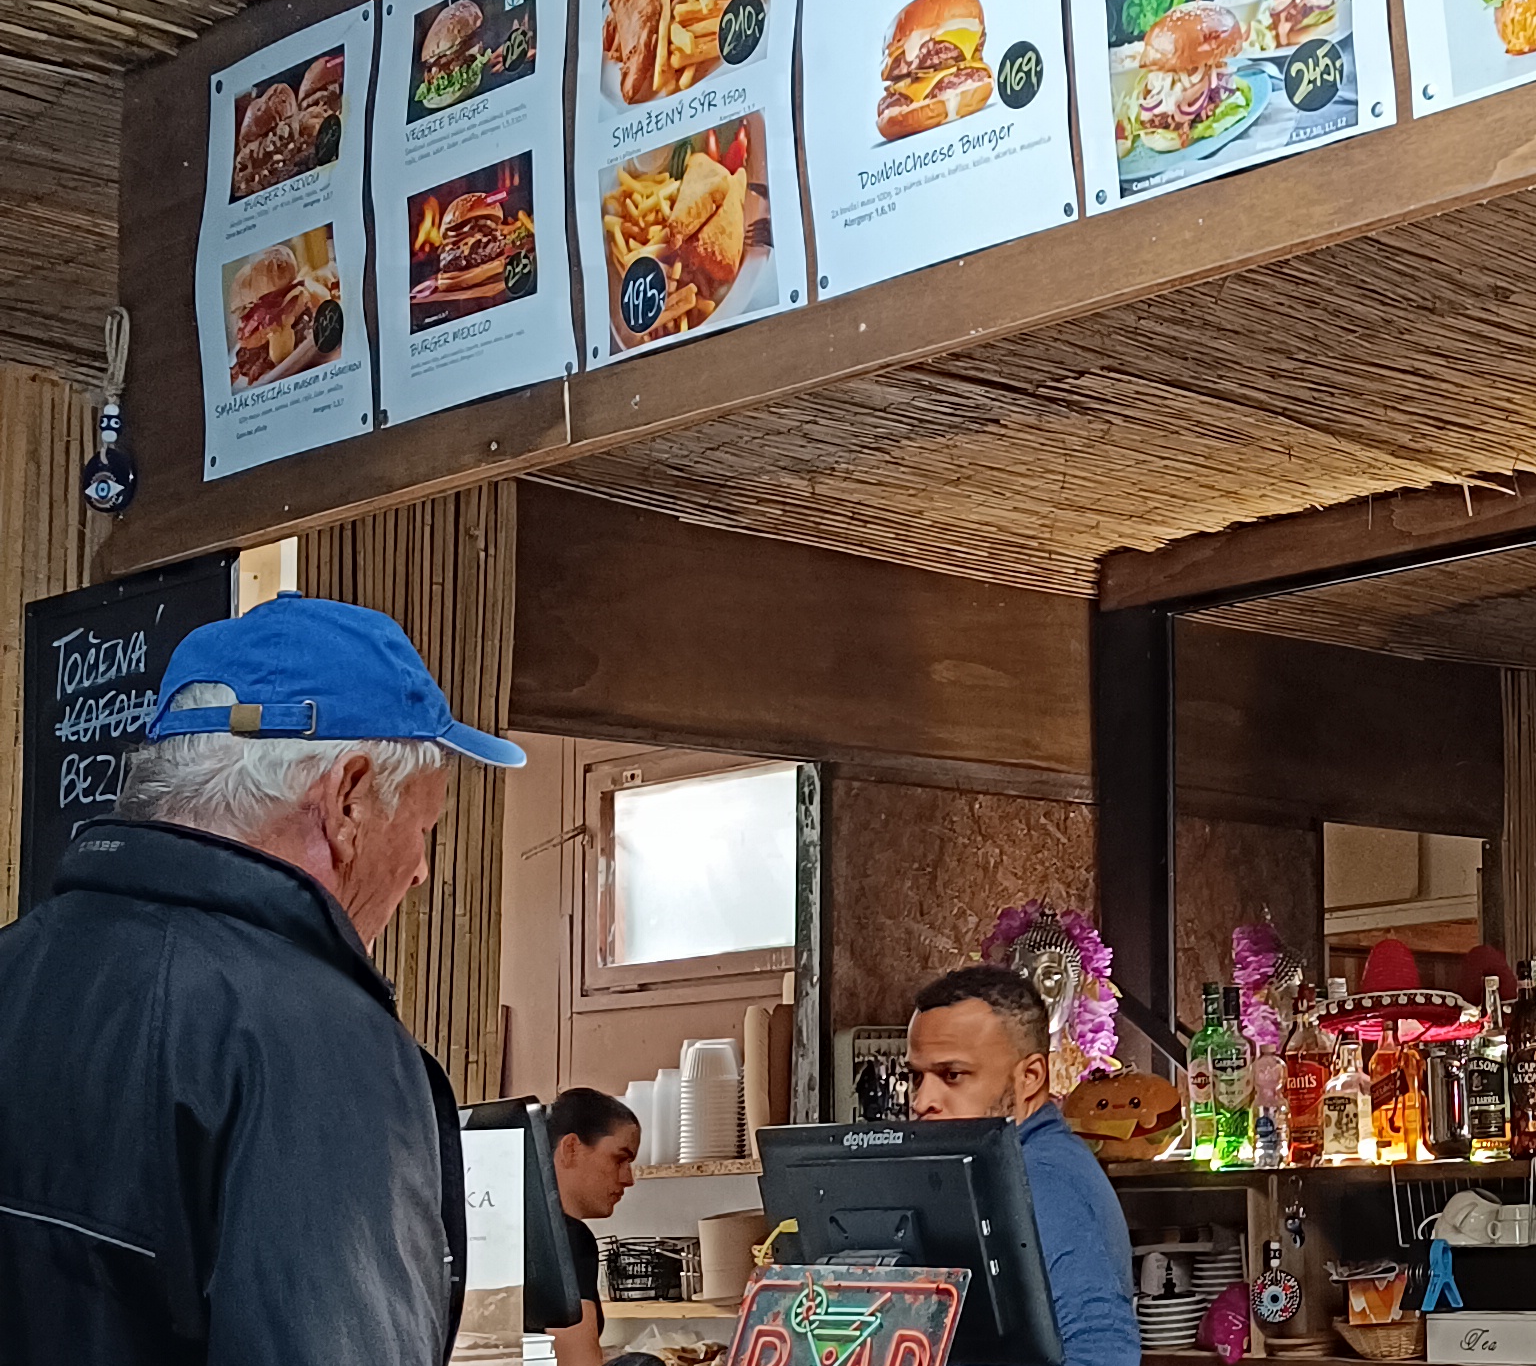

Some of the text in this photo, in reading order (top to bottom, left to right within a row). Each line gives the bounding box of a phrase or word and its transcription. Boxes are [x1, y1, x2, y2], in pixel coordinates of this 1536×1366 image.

[405, 111, 445, 142] VEGGIE
[448, 99, 489, 126] BURGER
[612, 99, 684, 148] SMAŽENÝ
[688, 90, 718, 118] SÝR
[858, 143, 956, 190] DoubleCheese
[959, 121, 1015, 152] Burger
[410, 332, 449, 356] BURGER
[452, 320, 491, 341] MEXICO
[843, 1129, 904, 1148] dotykačka
[1460, 1327, 1498, 1353] Tea
